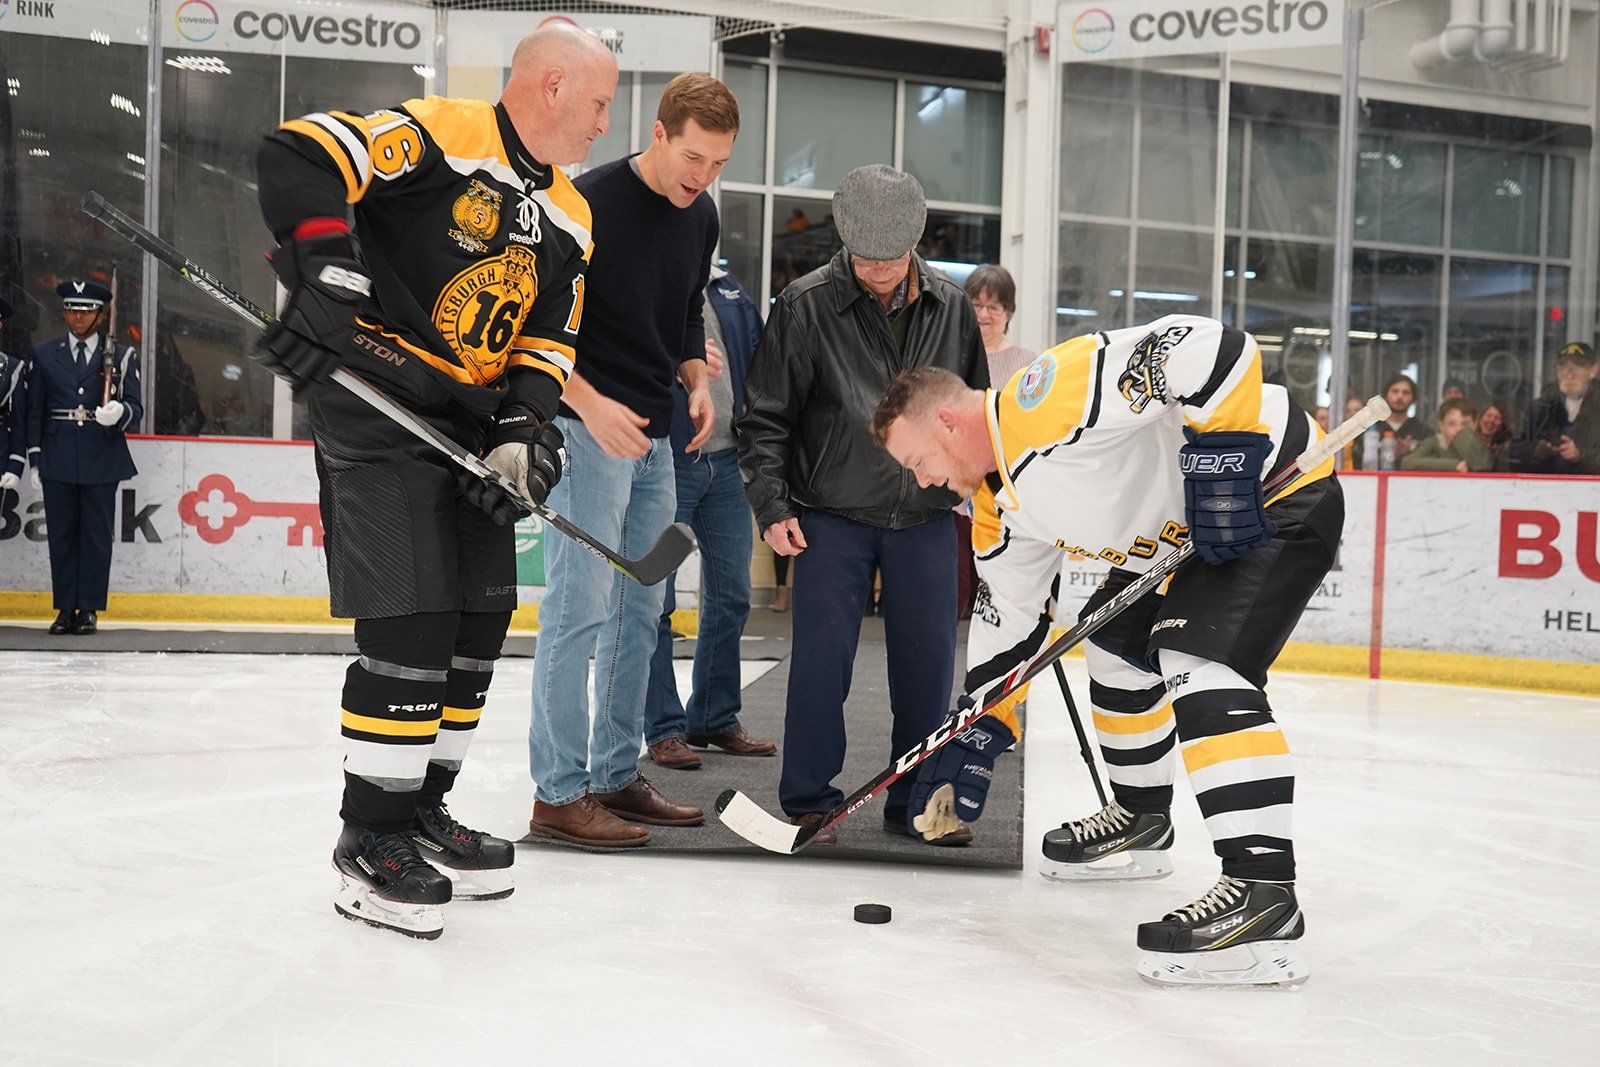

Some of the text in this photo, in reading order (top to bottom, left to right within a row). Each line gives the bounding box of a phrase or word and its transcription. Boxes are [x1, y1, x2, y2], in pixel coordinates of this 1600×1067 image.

[16, 0, 55, 19] RINK
[1129, 0, 1329, 43] covestro
[233, 10, 421, 50] covestro
[508, 232, 535, 246] Reeb
[461, 290, 522, 354] 16
[352, 333, 407, 367] STON
[498, 415, 528, 425] BAUER
[1179, 452, 1246, 474] UER
[0, 487, 163, 544] Bak
[1076, 540, 1194, 635] JETSPEED
[387, 702, 438, 713] TRON
[895, 693, 986, 775] CCM
[1097, 837, 1127, 852] CCM
[1210, 915, 1244, 934] CCM
